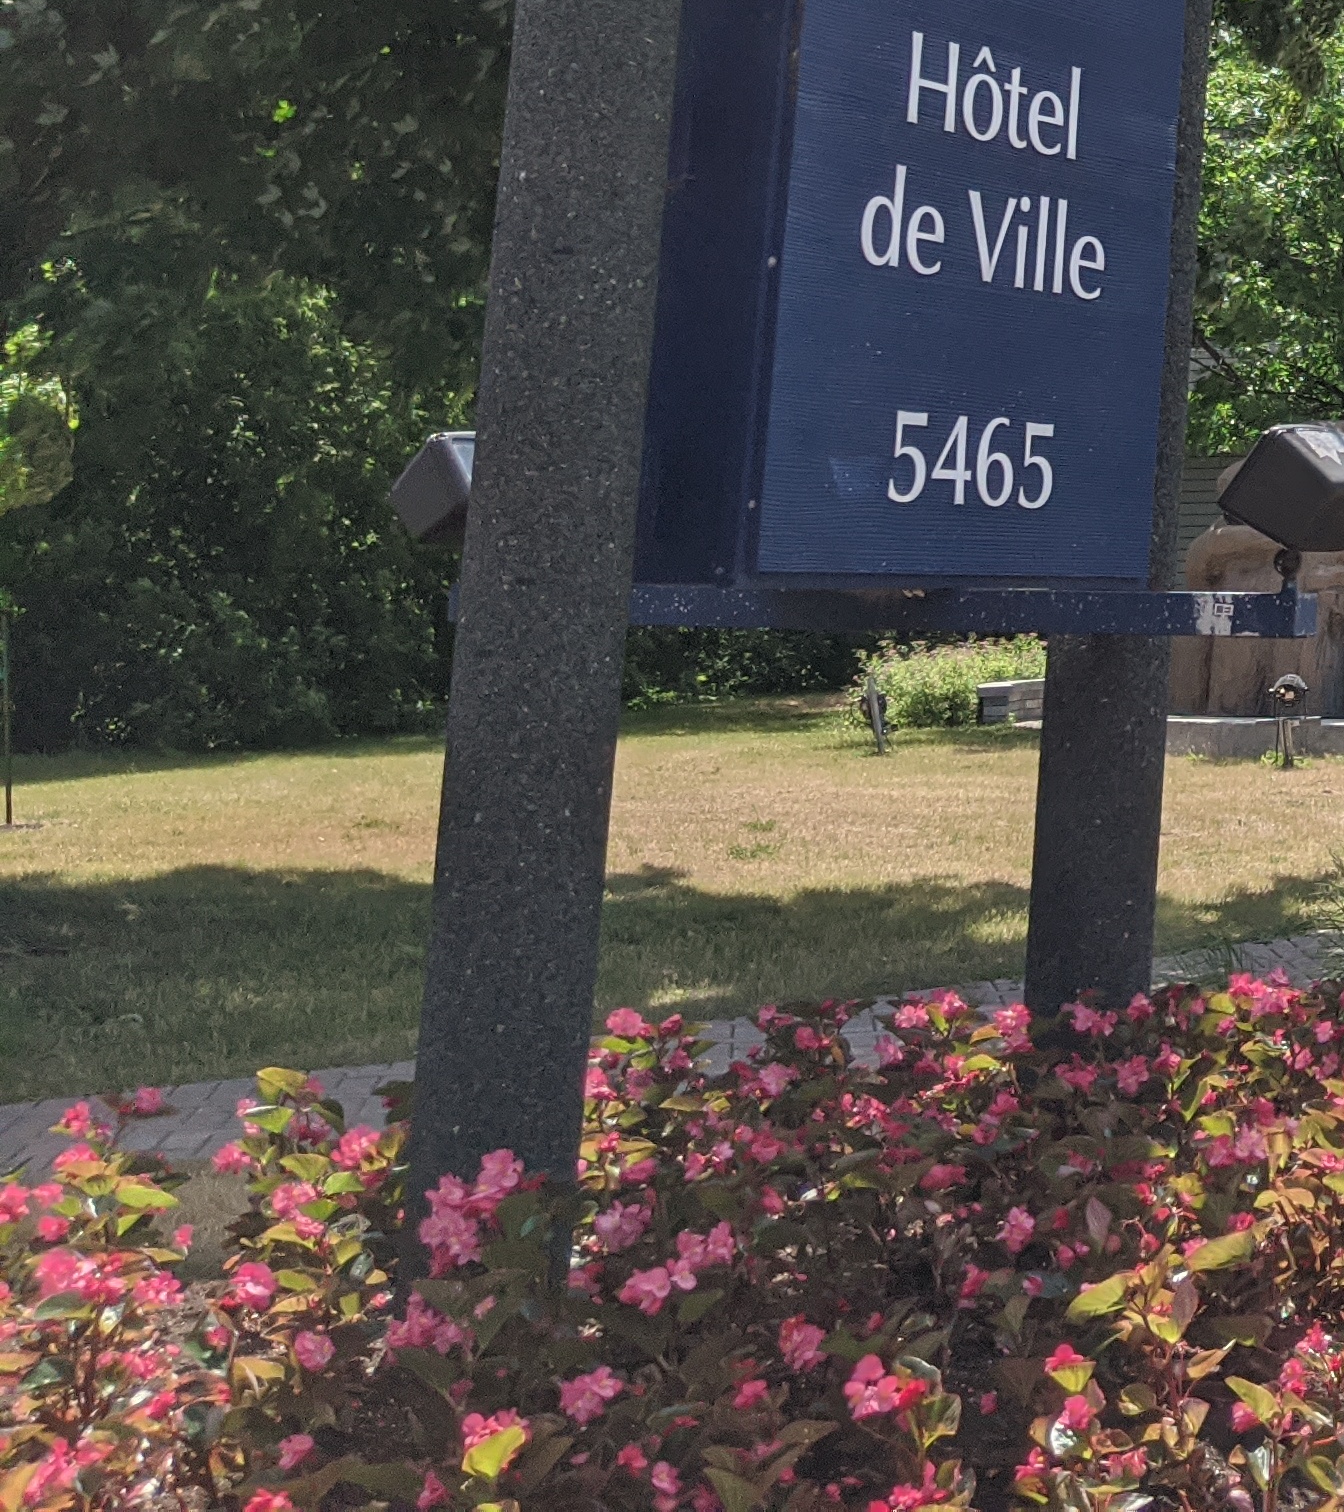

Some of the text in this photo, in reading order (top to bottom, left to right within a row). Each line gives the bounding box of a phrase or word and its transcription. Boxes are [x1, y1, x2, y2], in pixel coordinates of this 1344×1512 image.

[906, 30, 1082, 160] Hôtel
[860, 163, 1105, 300] de Ville
[887, 409, 1055, 509] 5465
